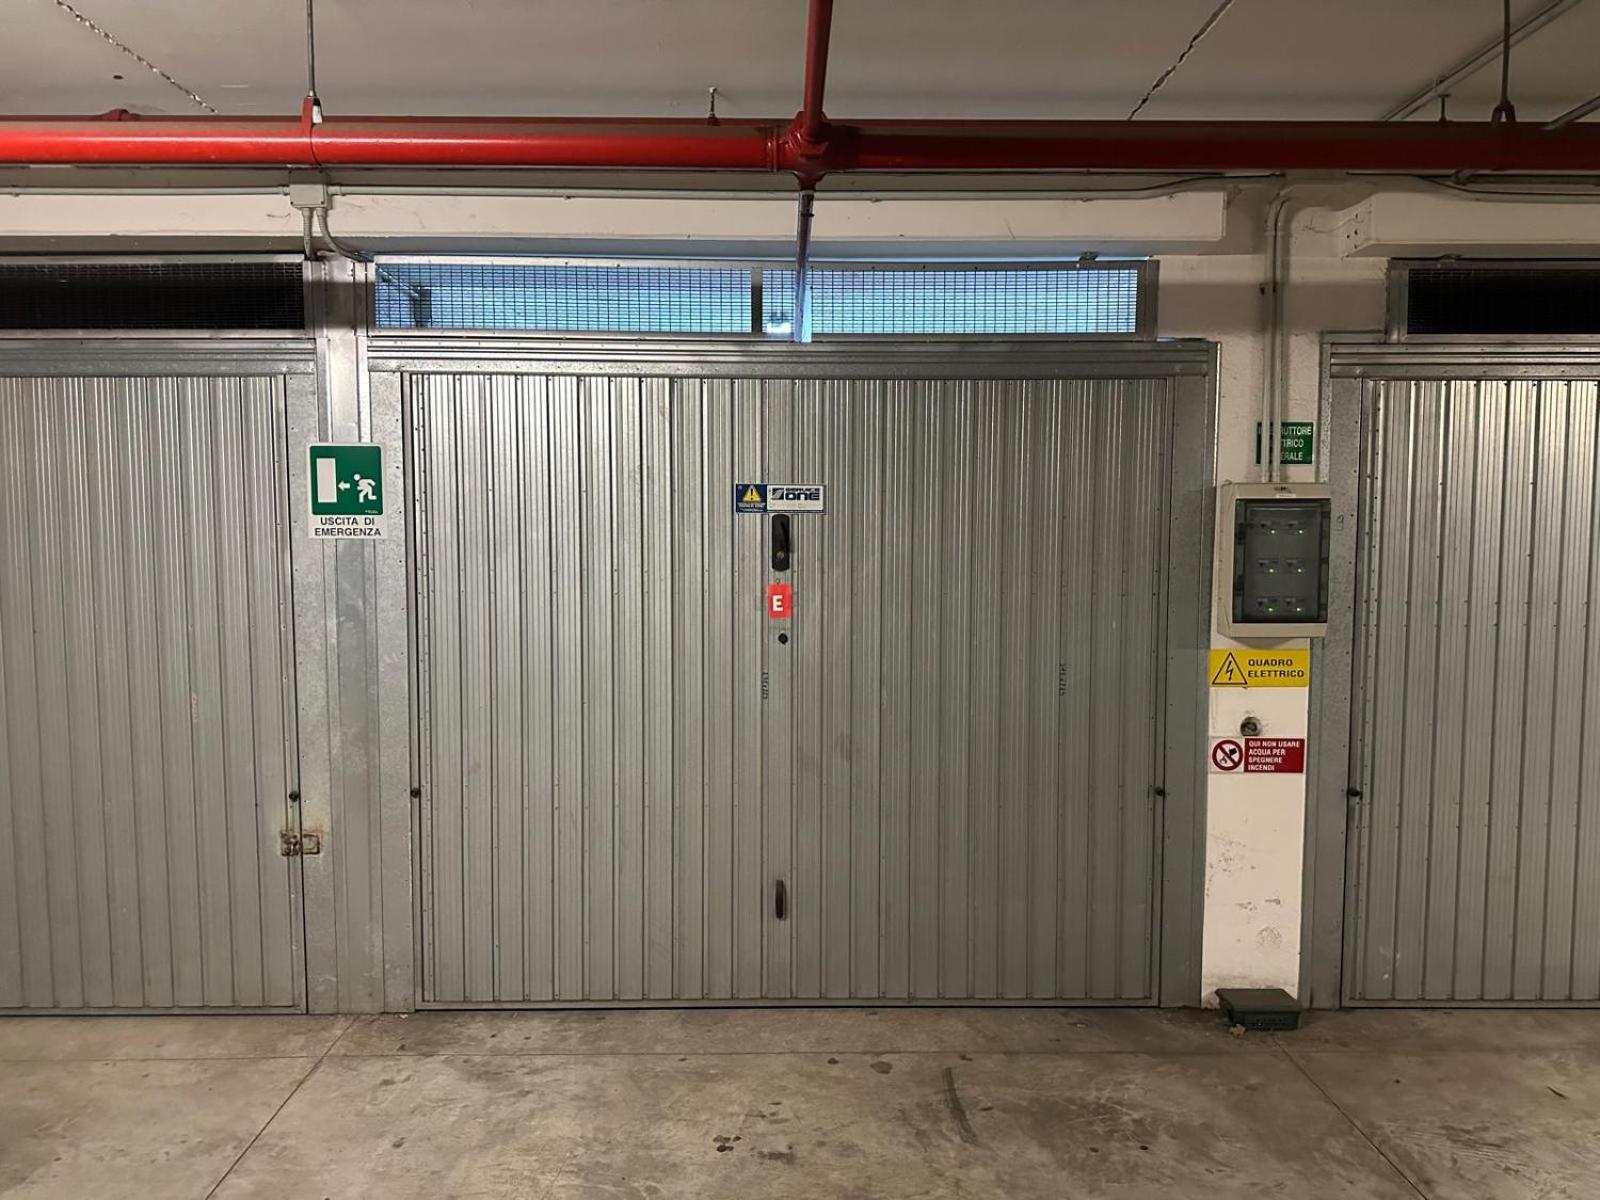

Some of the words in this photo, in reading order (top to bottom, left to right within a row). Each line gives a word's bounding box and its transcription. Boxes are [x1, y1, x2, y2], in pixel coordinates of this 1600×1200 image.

[320, 516, 359, 526] USCITA
[364, 516, 375, 526] DI
[314, 527, 382, 537] EMERGENZA
[772, 595, 784, 612] E
[1248, 659, 1293, 667] QUADRO
[1248, 670, 1305, 678] ELETTRICO
[1248, 740, 1261, 748] QUI
[1262, 740, 1277, 748] NON
[1278, 740, 1300, 748] USARE
[1248, 748, 1271, 756] ACQUA
[1272, 748, 1286, 756] PER
[1248, 756, 1283, 764] SPEGNERE
